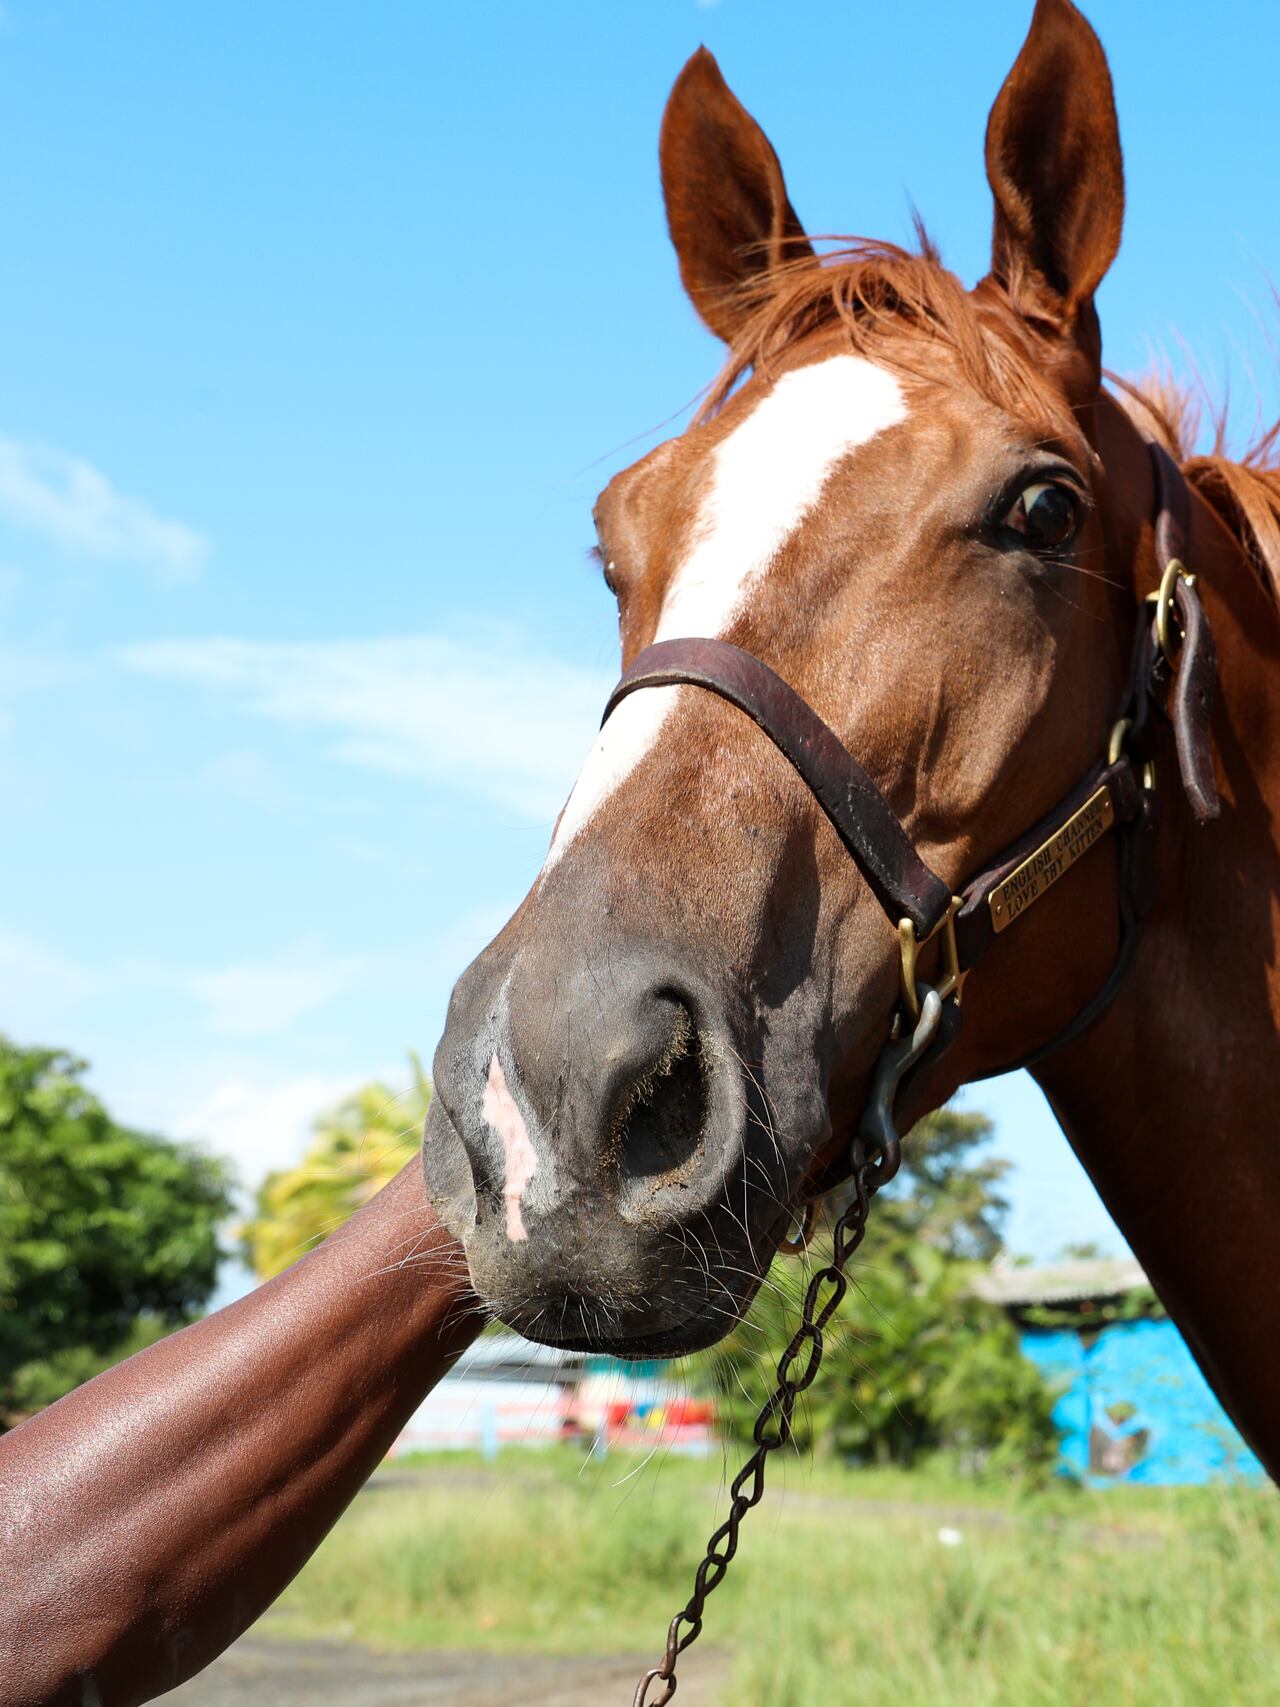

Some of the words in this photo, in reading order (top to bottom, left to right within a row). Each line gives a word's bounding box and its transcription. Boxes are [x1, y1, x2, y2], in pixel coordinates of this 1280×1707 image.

[1002, 848, 1051, 901] ENGLISH
[1056, 803, 1104, 852] CHANNEL
[1006, 881, 1039, 918] LOVE
[1044, 856, 1064, 884] THY
[1070, 817, 1104, 860] KITTEN
